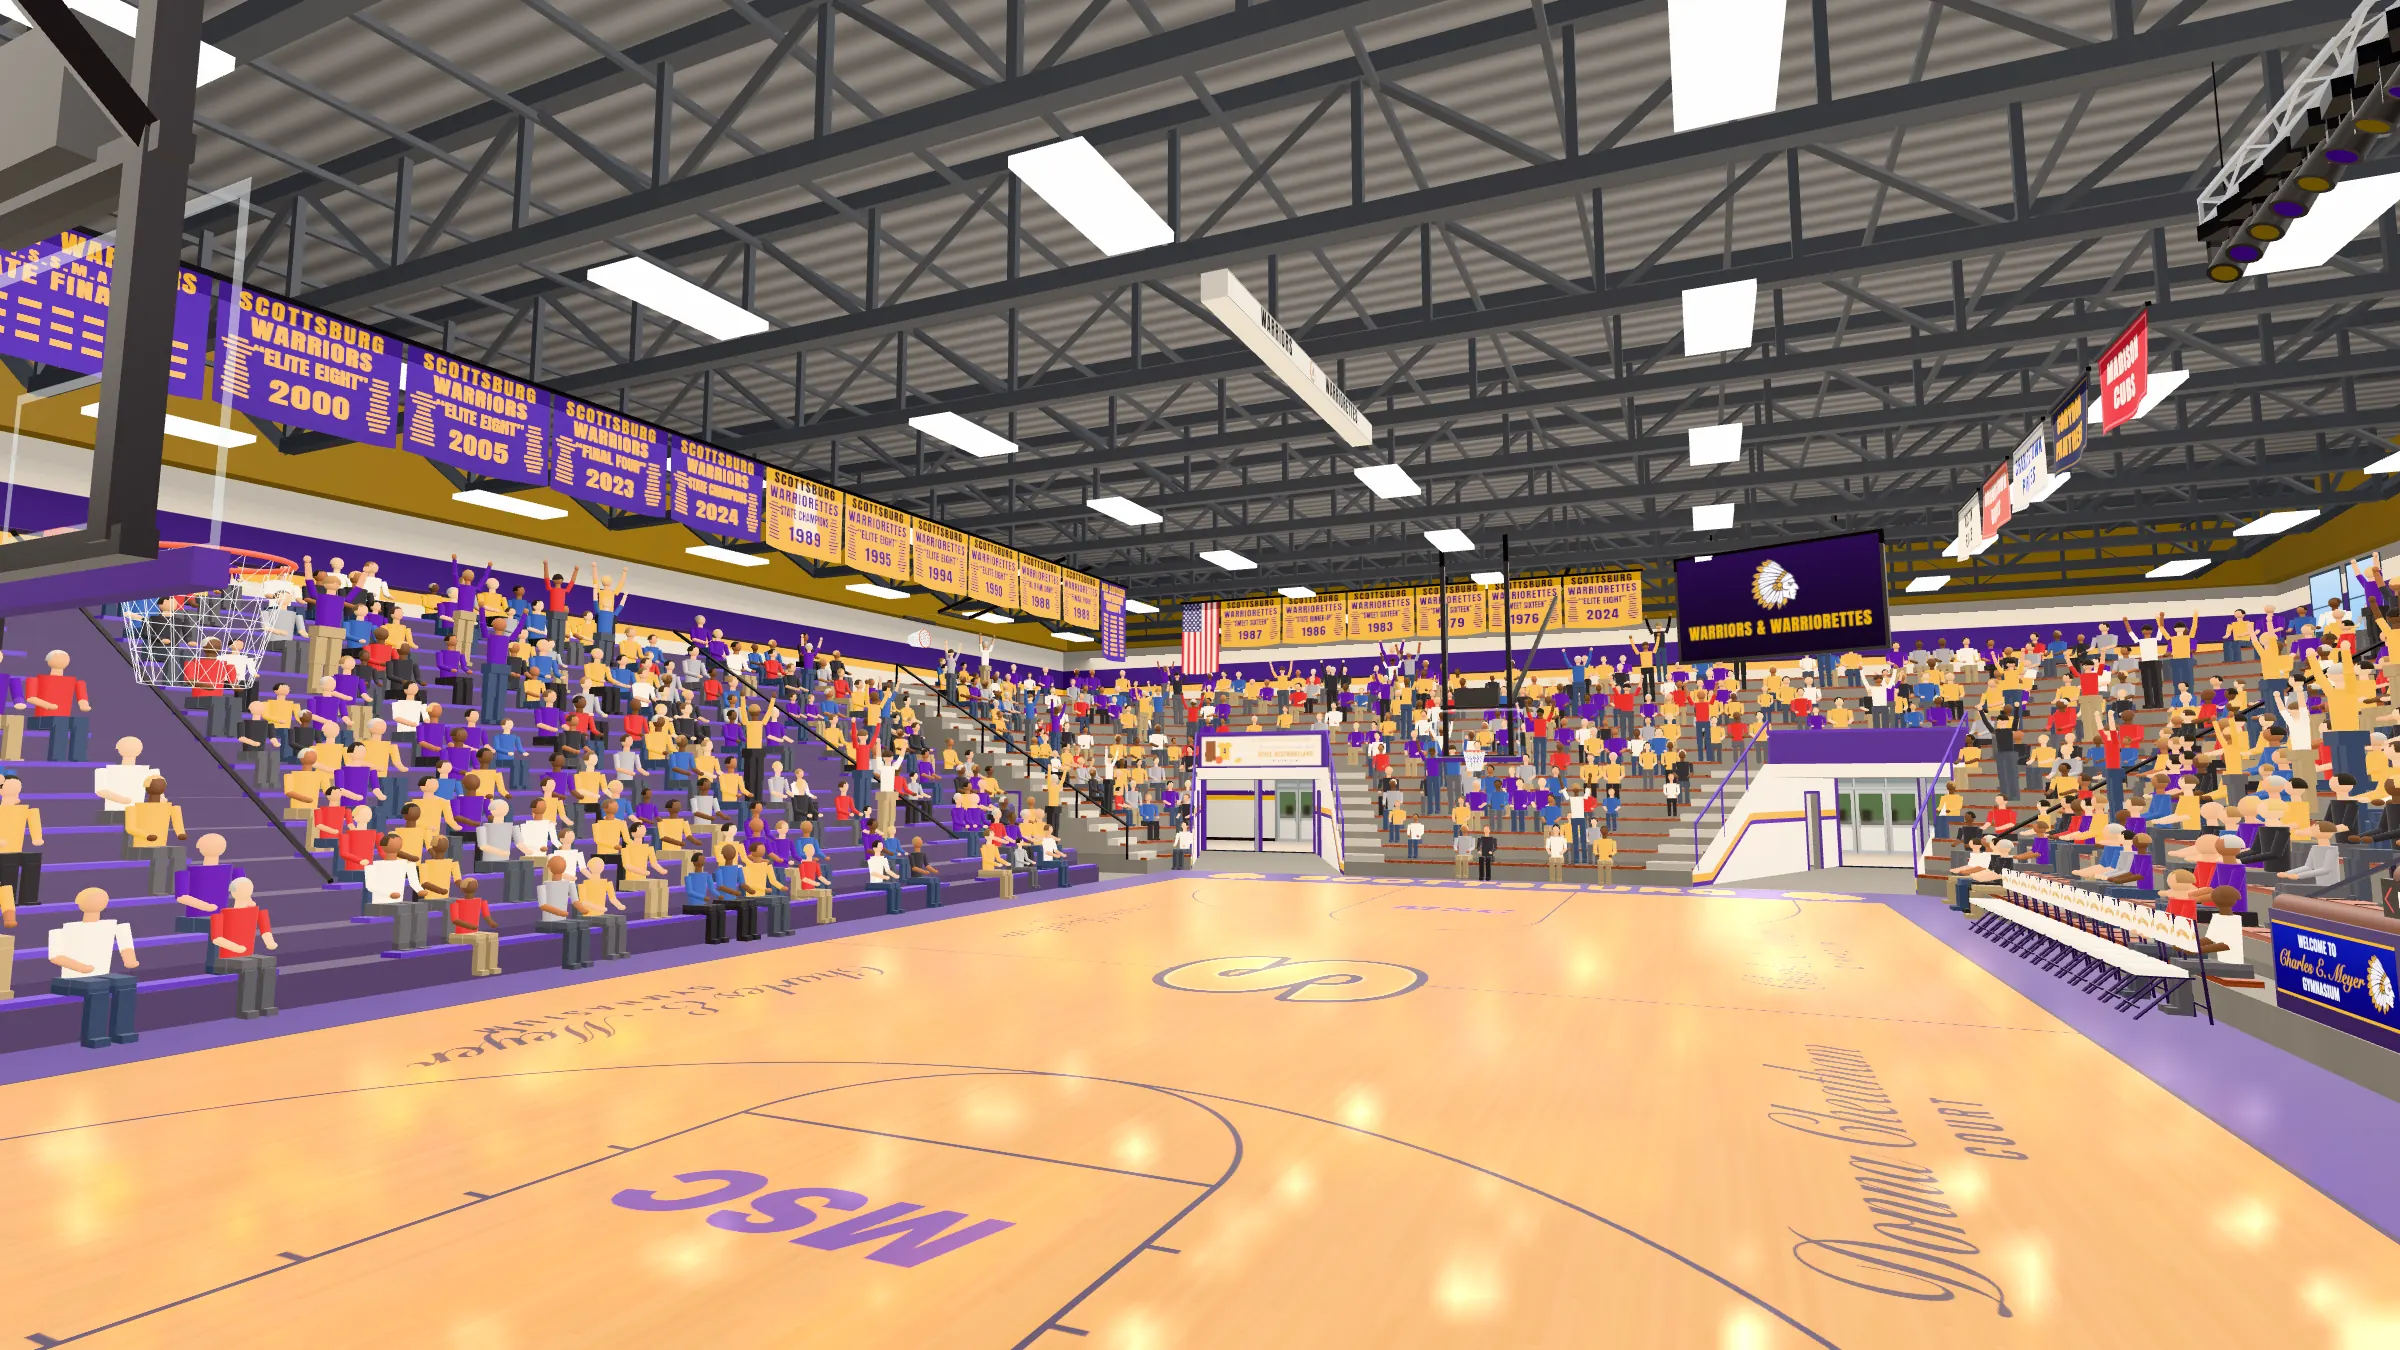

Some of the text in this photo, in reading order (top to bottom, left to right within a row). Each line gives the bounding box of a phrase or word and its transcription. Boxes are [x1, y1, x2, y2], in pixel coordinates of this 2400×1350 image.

[239, 290, 385, 355] SCOTTSBURG
[1260, 305, 1293, 356] WARRIORS
[251, 317, 373, 373] WARRIORS
[2106, 333, 2139, 387] MADISON
[423, 353, 537, 404] SCOTTSBURG
[268, 379, 350, 421] 2000
[433, 374, 528, 421] WARRIORS
[1325, 376, 1358, 425] WARRIORETTES
[2113, 373, 2136, 410] CUBS
[566, 400, 657, 444] SCOTTSBURG
[448, 429, 509, 465] 2005
[573, 420, 649, 459] WARRIORS
[681, 439, 755, 476] SCOTTSBURG
[585, 468, 635, 499] 2023
[687, 457, 749, 490] WARRIORS
[774, 471, 835, 501] SCOTTSBURG
[695, 499, 739, 526] 2024
[770, 484, 839, 517] WARRIORETTES
[852, 498, 904, 524] SCOTTSBURG
[848, 509, 907, 538] WARRIORETTES
[918, 520, 963, 543] SCOTTSBURG
[789, 526, 821, 548] 1989
[915, 531, 965, 556] WARRIORETTES
[974, 539, 1013, 560] SCOTTSBURG
[865, 547, 892, 567] 1995
[971, 549, 1016, 572] WARRIORETTES
[1023, 555, 1057, 574] SCOTTSBURG
[929, 566, 953, 583] 1994
[1021, 565, 1059, 585] WARRIORETTES
[1571, 573, 1632, 585] SCOTTSBURG
[985, 581, 1003, 598] 1990
[1353, 589, 1406, 600] SCOTTSBURG
[1419, 593, 1482, 606] WARORETTES
[1422, 584, 1478, 596] SCOTSBURG
[1491, 587, 1557, 601] WARIORETTES
[1567, 582, 1637, 596] WARRIORETTES
[1031, 595, 1050, 610] 1988
[1224, 607, 1278, 618] WARRIORETTES
[1226, 599, 1274, 608] SCOTTSBURG
[1285, 603, 1343, 614] WARRIORETTES
[1351, 598, 1411, 610] WARRIORETTES
[1586, 607, 1619, 620] 2024
[1302, 625, 1326, 637] 1986
[1367, 621, 1393, 633] 1983
[1437, 617, 1465, 629] 179
[1510, 612, 1539, 625] 1976
[1688, 609, 1873, 642] WARRIORS & WARRIORETTES
[1238, 629, 1262, 640] 1987
[1292, 875, 1738, 896] SCOTTSBURG
[2296, 933, 2337, 958] WELCOME TO
[2279, 948, 2366, 993] Charles E. Meyer
[2301, 976, 2341, 1003] GYMNASIUM
[406, 1011, 634, 1069] Meyer
[1761, 1043, 1918, 1148] Cheatham
[1927, 1097, 2030, 1161] COURT
[610, 1169, 1018, 1269] MSC
[1787, 1152, 2014, 1319] Donna
